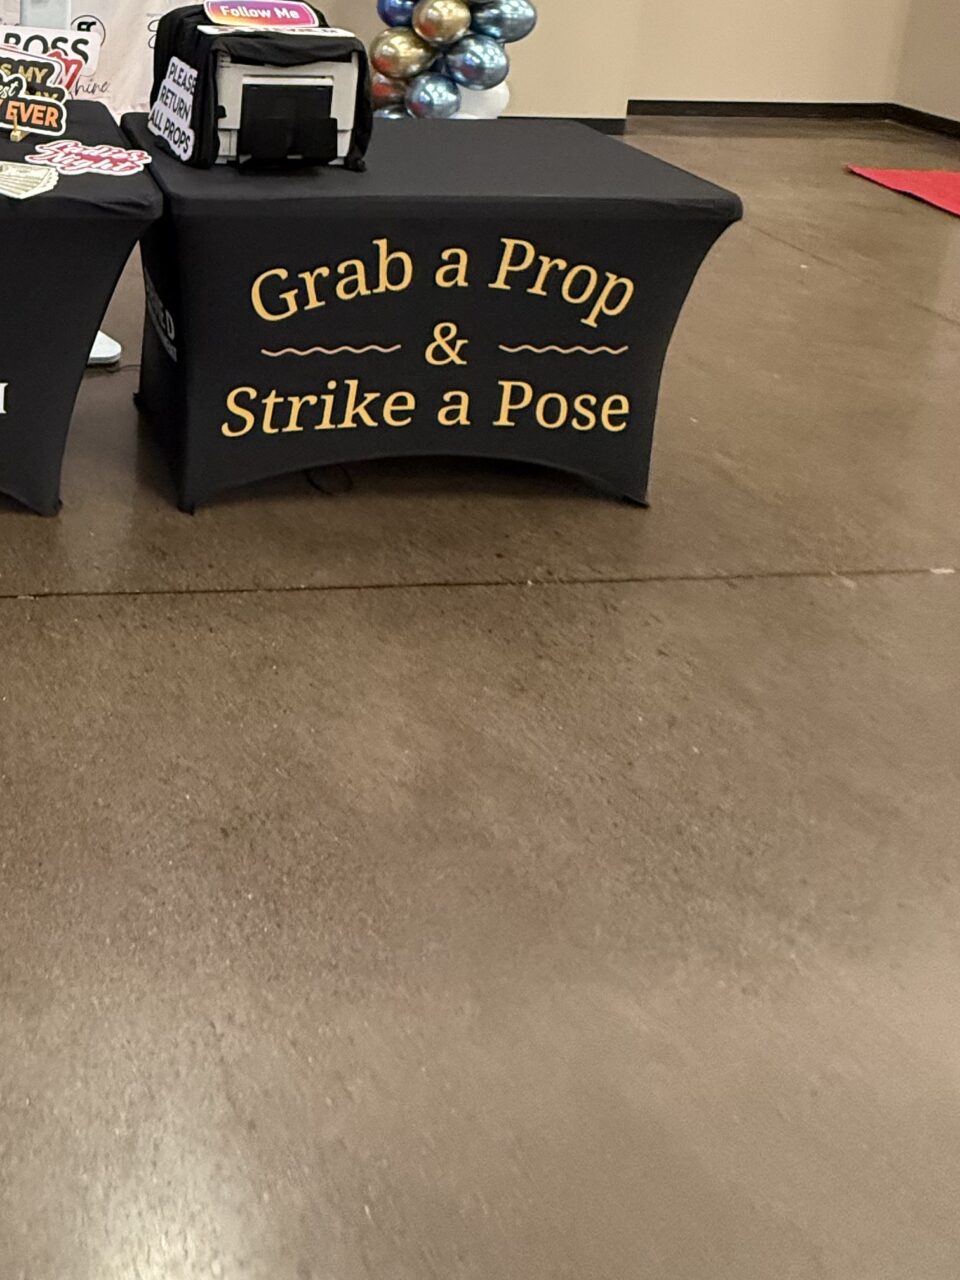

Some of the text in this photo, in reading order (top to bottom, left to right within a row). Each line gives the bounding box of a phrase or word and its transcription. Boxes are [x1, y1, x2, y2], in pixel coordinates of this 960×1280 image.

[220, 5, 300, 19] Follow Me
[18, 64, 49, 84] MY
[168, 63, 196, 94] PLEASE
[6, 97, 60, 128] EVER
[159, 86, 191, 119] RETURN
[150, 110, 191, 154] ALL PROPS
[250, 238, 414, 322] Grab
[435, 248, 469, 288] a
[488, 237, 635, 328] Prop
[424, 322, 469, 366] &
[220, 379, 631, 439] Strike a Pose
